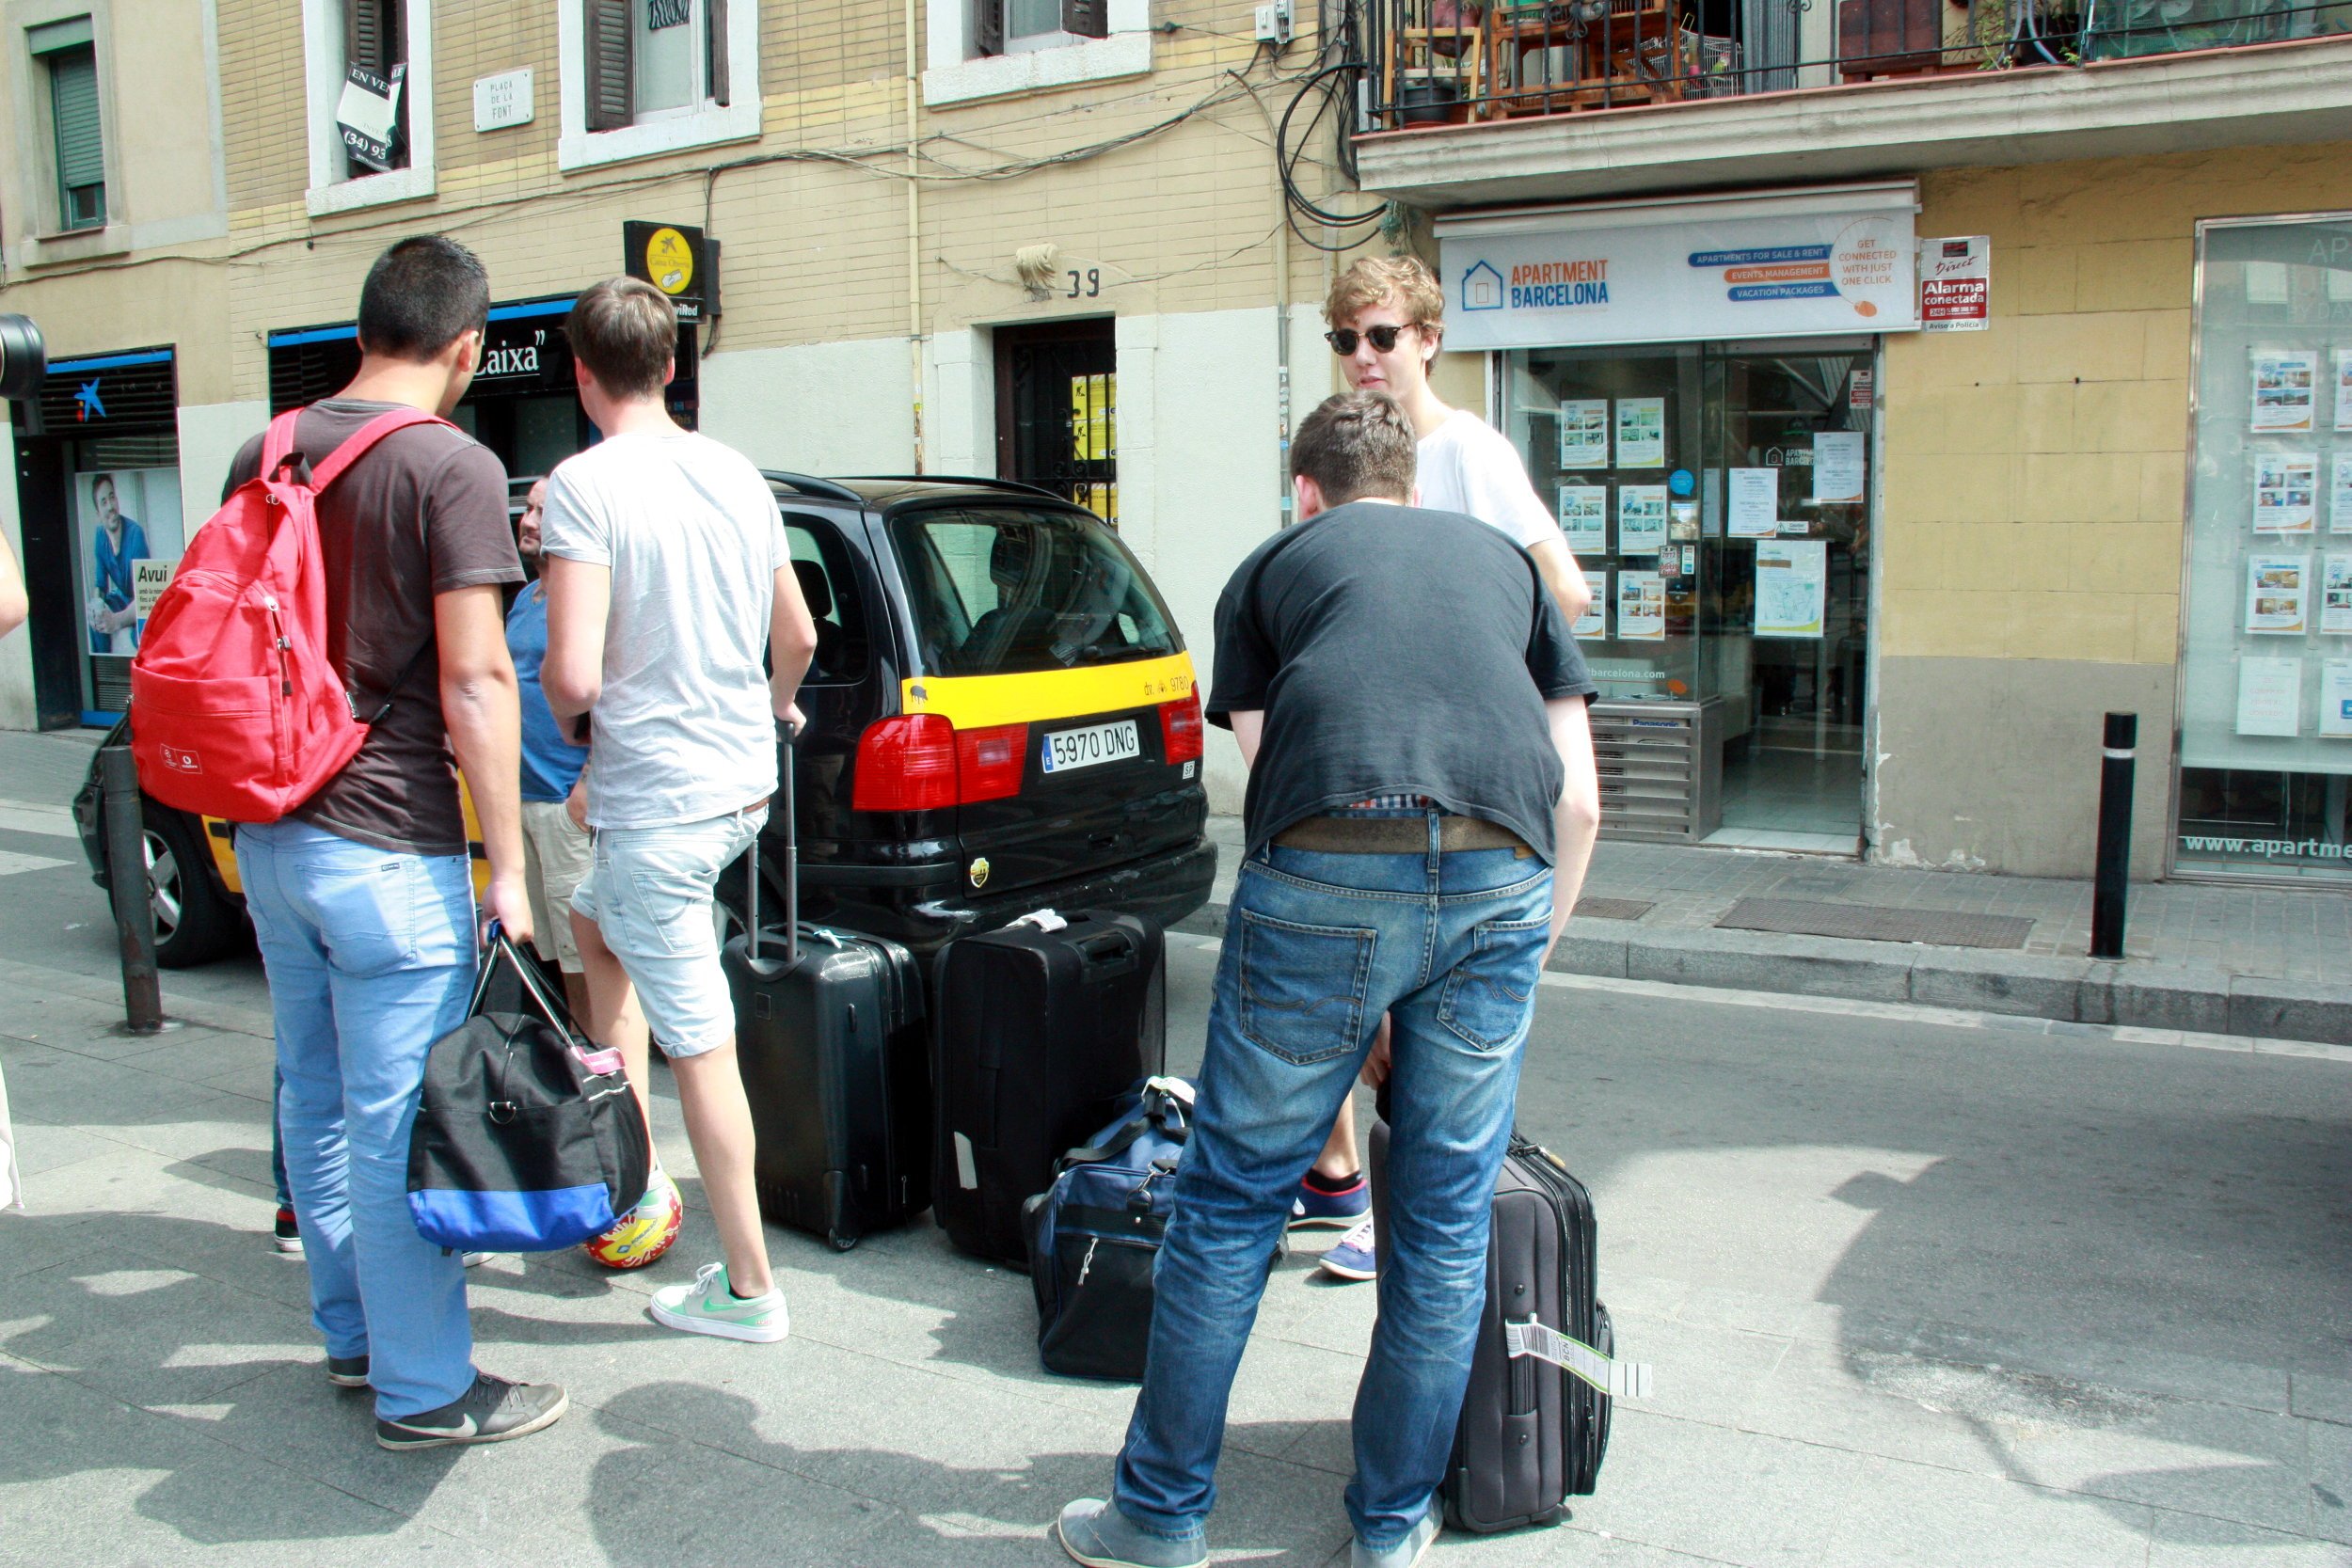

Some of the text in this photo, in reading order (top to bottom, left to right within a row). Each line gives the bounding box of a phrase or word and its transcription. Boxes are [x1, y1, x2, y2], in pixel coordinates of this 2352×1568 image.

[352, 68, 369, 84] EN
[491, 93, 513, 104] DE LA
[492, 104, 512, 119] FONT
[343, 131, 369, 151] (34)
[1857, 239, 1876, 248] GET
[2308, 237, 2352, 263] AP
[1696, 252, 1751, 264] APARTMENTS
[1754, 251, 1770, 261] FOR
[1772, 250, 1792, 260] SALE
[1803, 247, 1823, 257] RENT
[1838, 250, 1897, 261] CONNECTED
[1512, 260, 1608, 285] APARTMENT
[1731, 266, 1824, 280] EVENTS MANAGEMENT
[1843, 262, 1893, 274] WITH JUST
[1934, 256, 1979, 276] Direct
[1067, 268, 1100, 298] 39
[1841, 276, 1892, 286] ONE CLICK
[1925, 281, 1984, 294] Alarma
[1511, 282, 1609, 309] BARCELONA
[1737, 285, 1824, 298] VACATION PACKAGES
[1925, 293, 1984, 305] conectada
[138, 565, 167, 582] Avui
[1169, 675, 1189, 692] 9780
[1045, 726, 1135, 766] E 5970 DNG
[1184, 764, 1194, 776] SP
